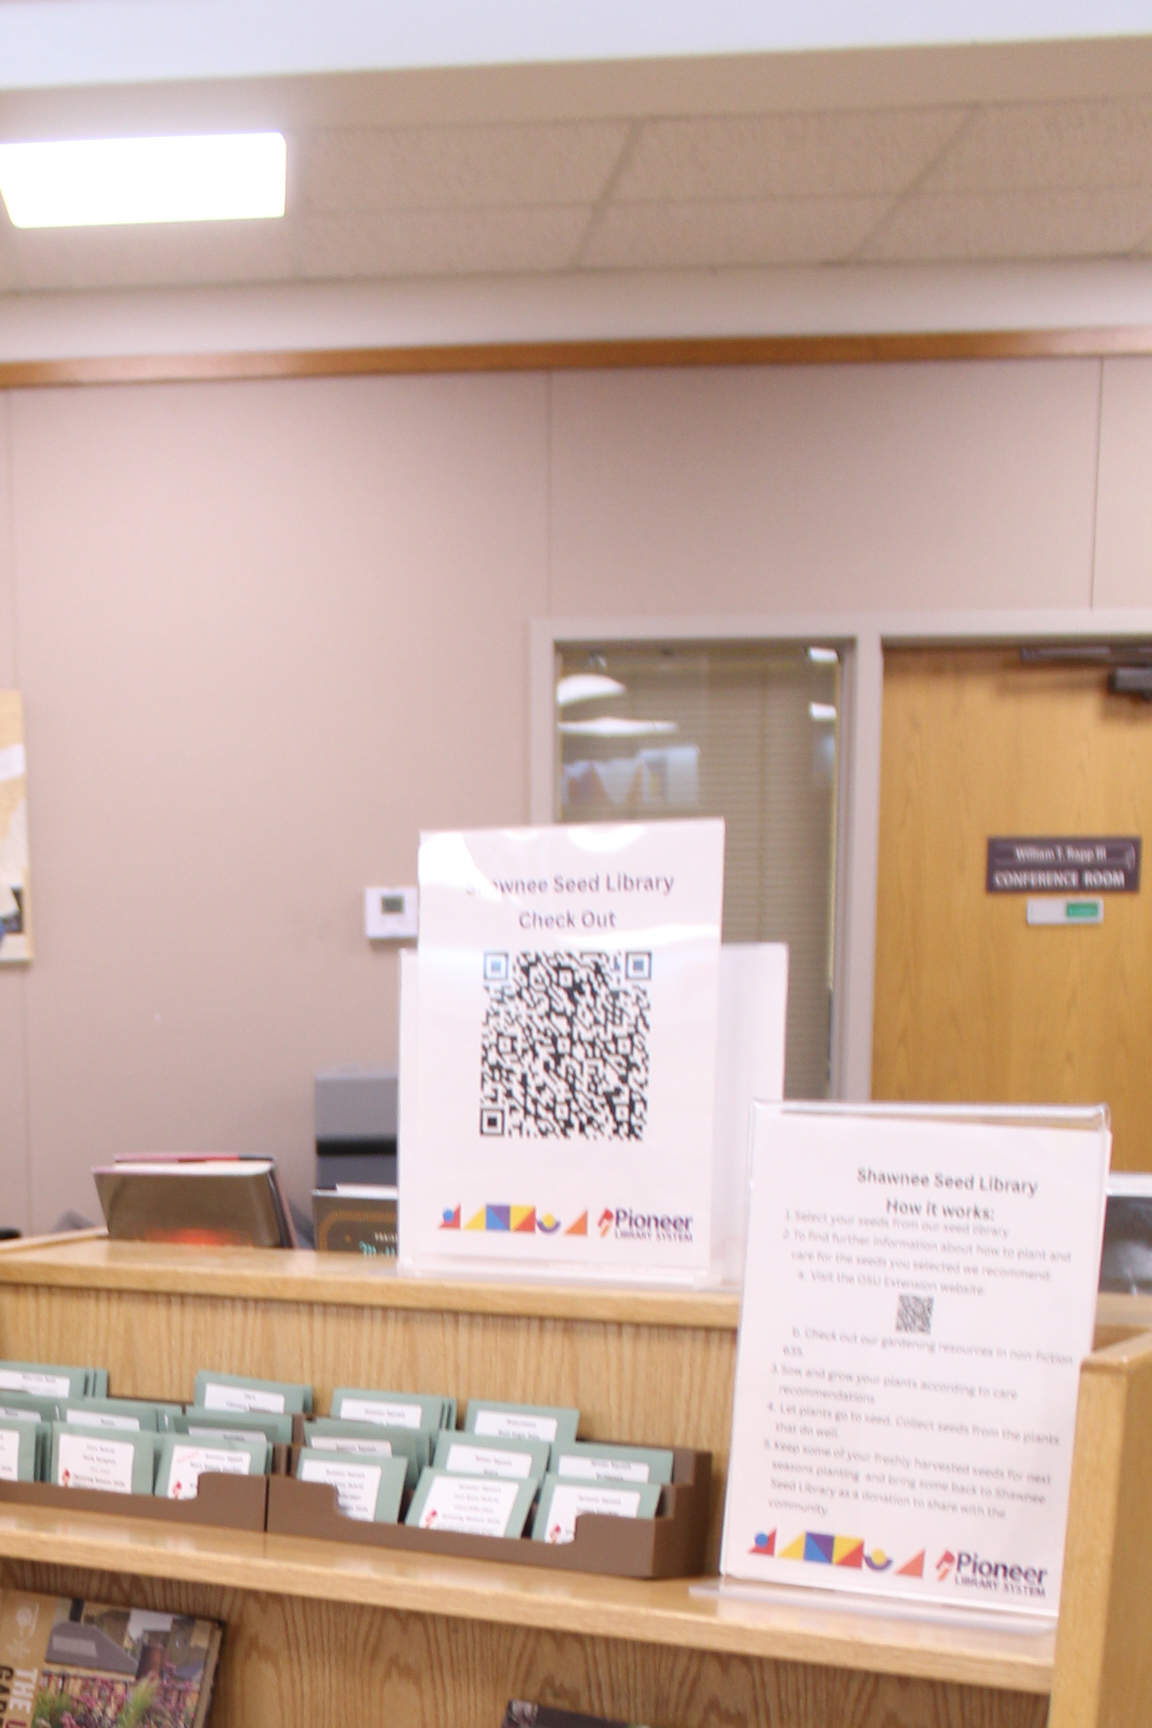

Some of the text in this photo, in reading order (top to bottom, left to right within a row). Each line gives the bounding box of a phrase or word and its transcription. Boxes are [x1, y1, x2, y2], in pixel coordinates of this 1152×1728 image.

[552, 871, 675, 897] Seed Library
[993, 868, 1126, 889] CONFERENCE ROOM
[518, 908, 617, 929] Check Out
[856, 1167, 1038, 1199] Shawnee Seed Library
[614, 1207, 694, 1231] Pioneer
[885, 1198, 996, 1221] How it works:
[614, 1228, 695, 1244] LIBRARY SYSTEM
[955, 1551, 1048, 1583] Pioneer
[955, 1574, 1047, 1598] LIBRARY SYSTEM
[8, 1667, 39, 1715] THE
